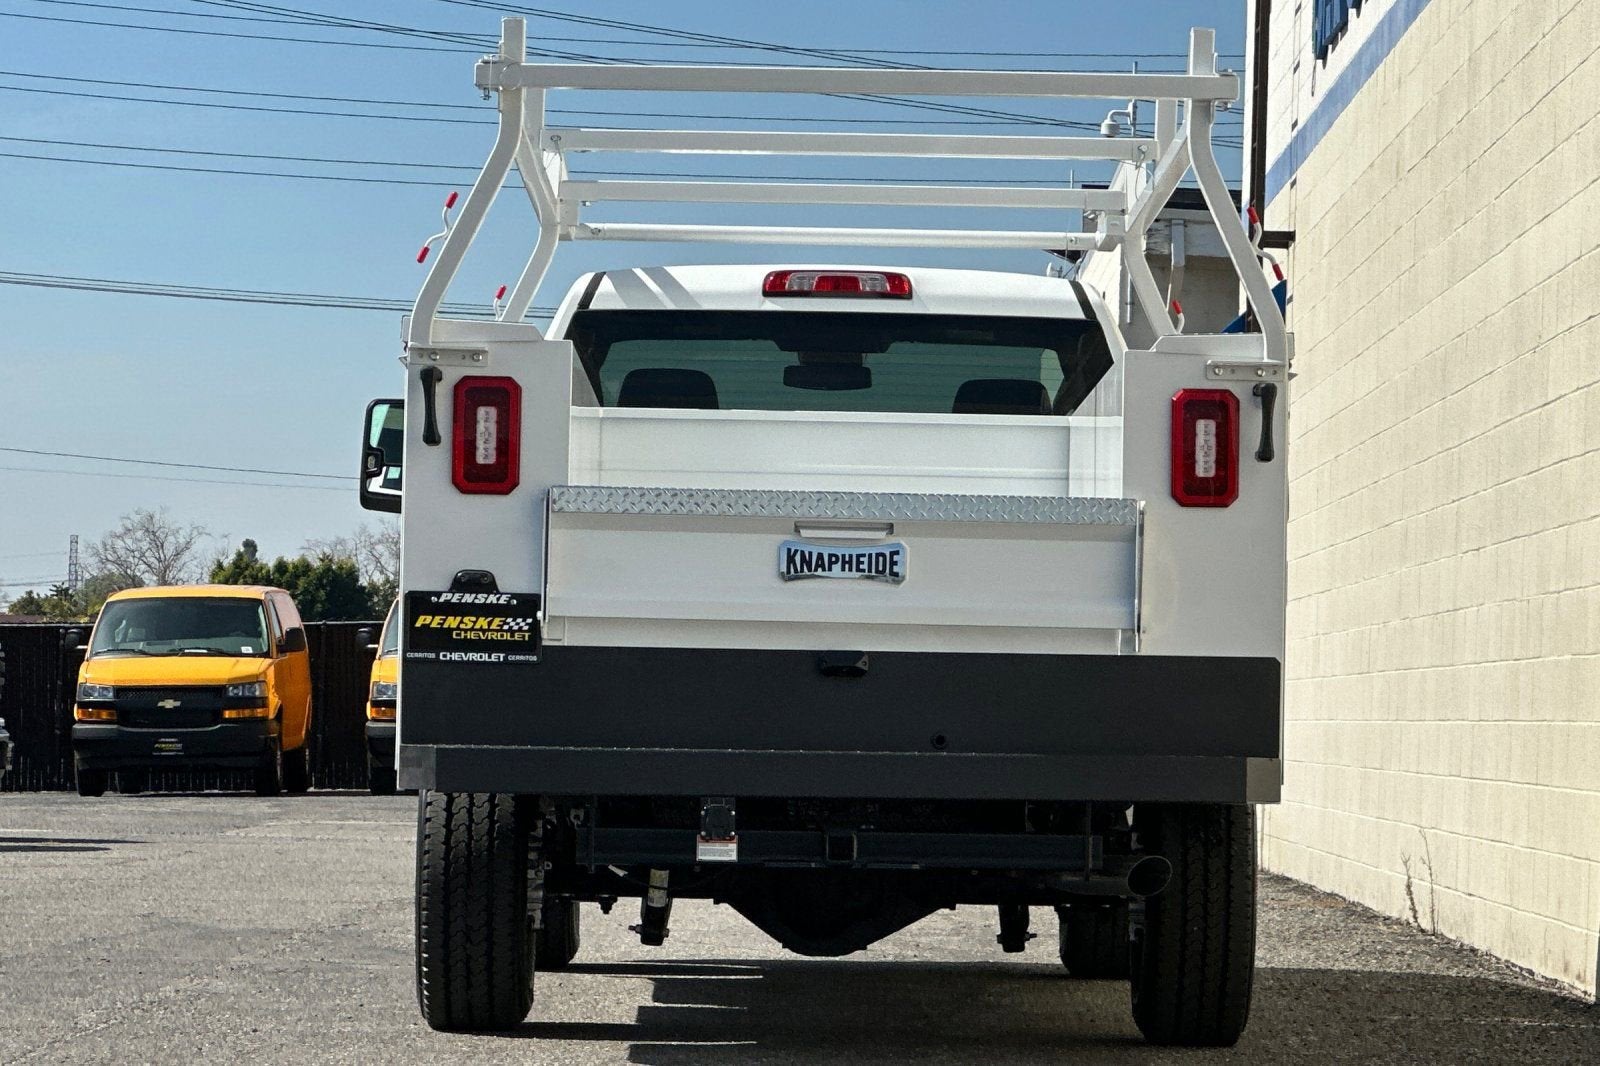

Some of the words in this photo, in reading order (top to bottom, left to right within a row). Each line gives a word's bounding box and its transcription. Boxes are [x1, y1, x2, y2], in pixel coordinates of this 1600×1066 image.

[785, 547, 900, 577] KNAPHEIDE
[439, 592, 511, 604] PENSKE
[414, 615, 505, 630] PENSKE
[452, 630, 531, 641] CHEVROLET
[439, 651, 505, 662] CHEVROLET
